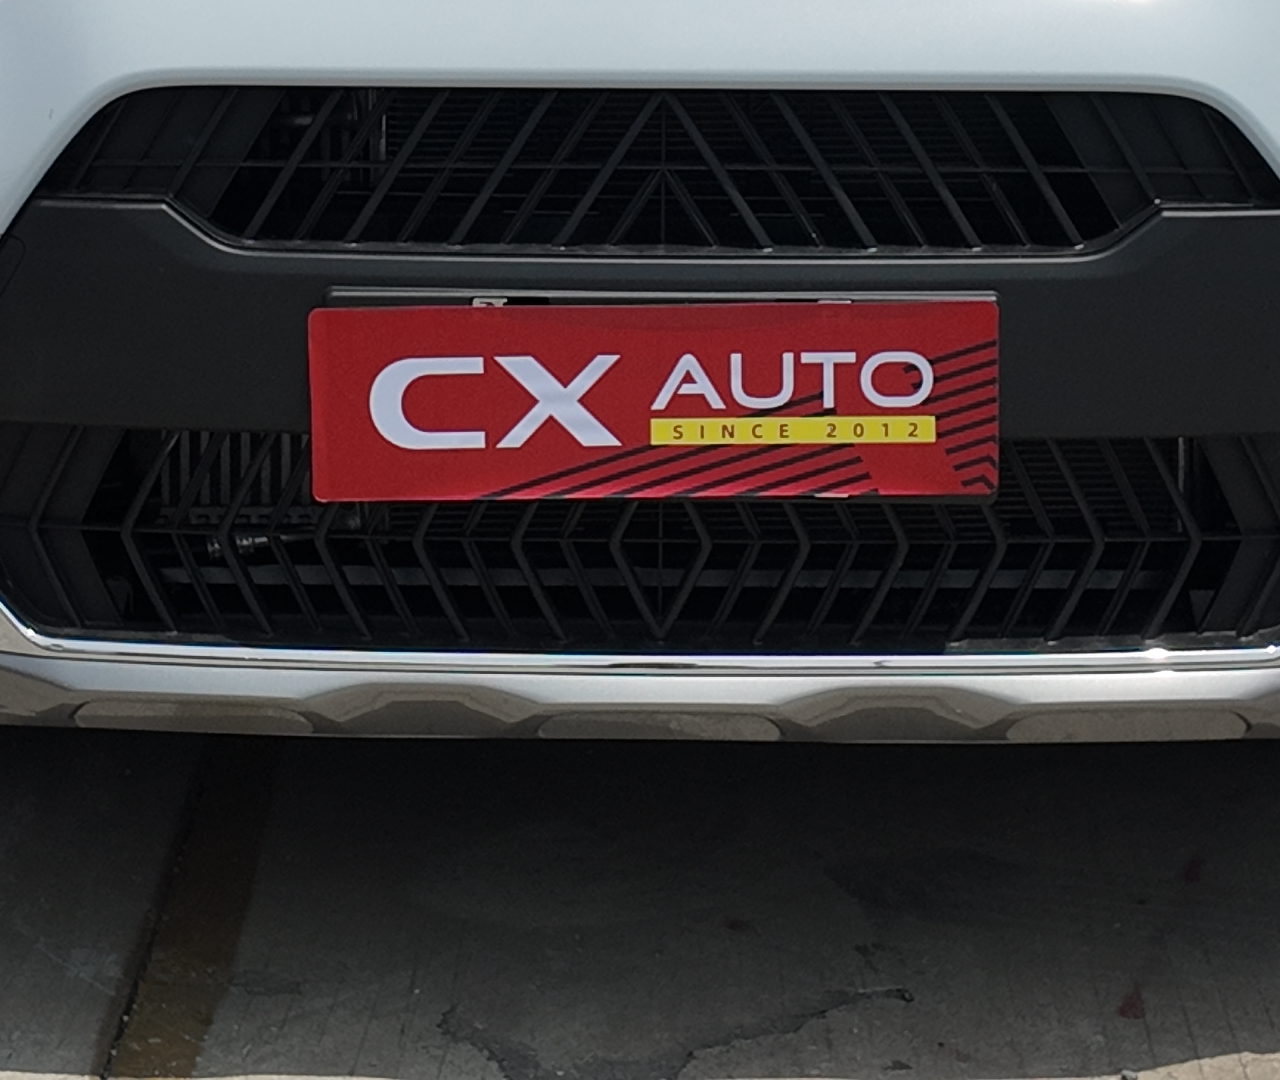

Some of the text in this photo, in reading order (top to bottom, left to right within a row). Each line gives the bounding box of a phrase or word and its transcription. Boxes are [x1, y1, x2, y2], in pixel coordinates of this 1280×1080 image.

[368, 351, 935, 450] CX AUTO
[672, 422, 922, 441] SINCE 2012
